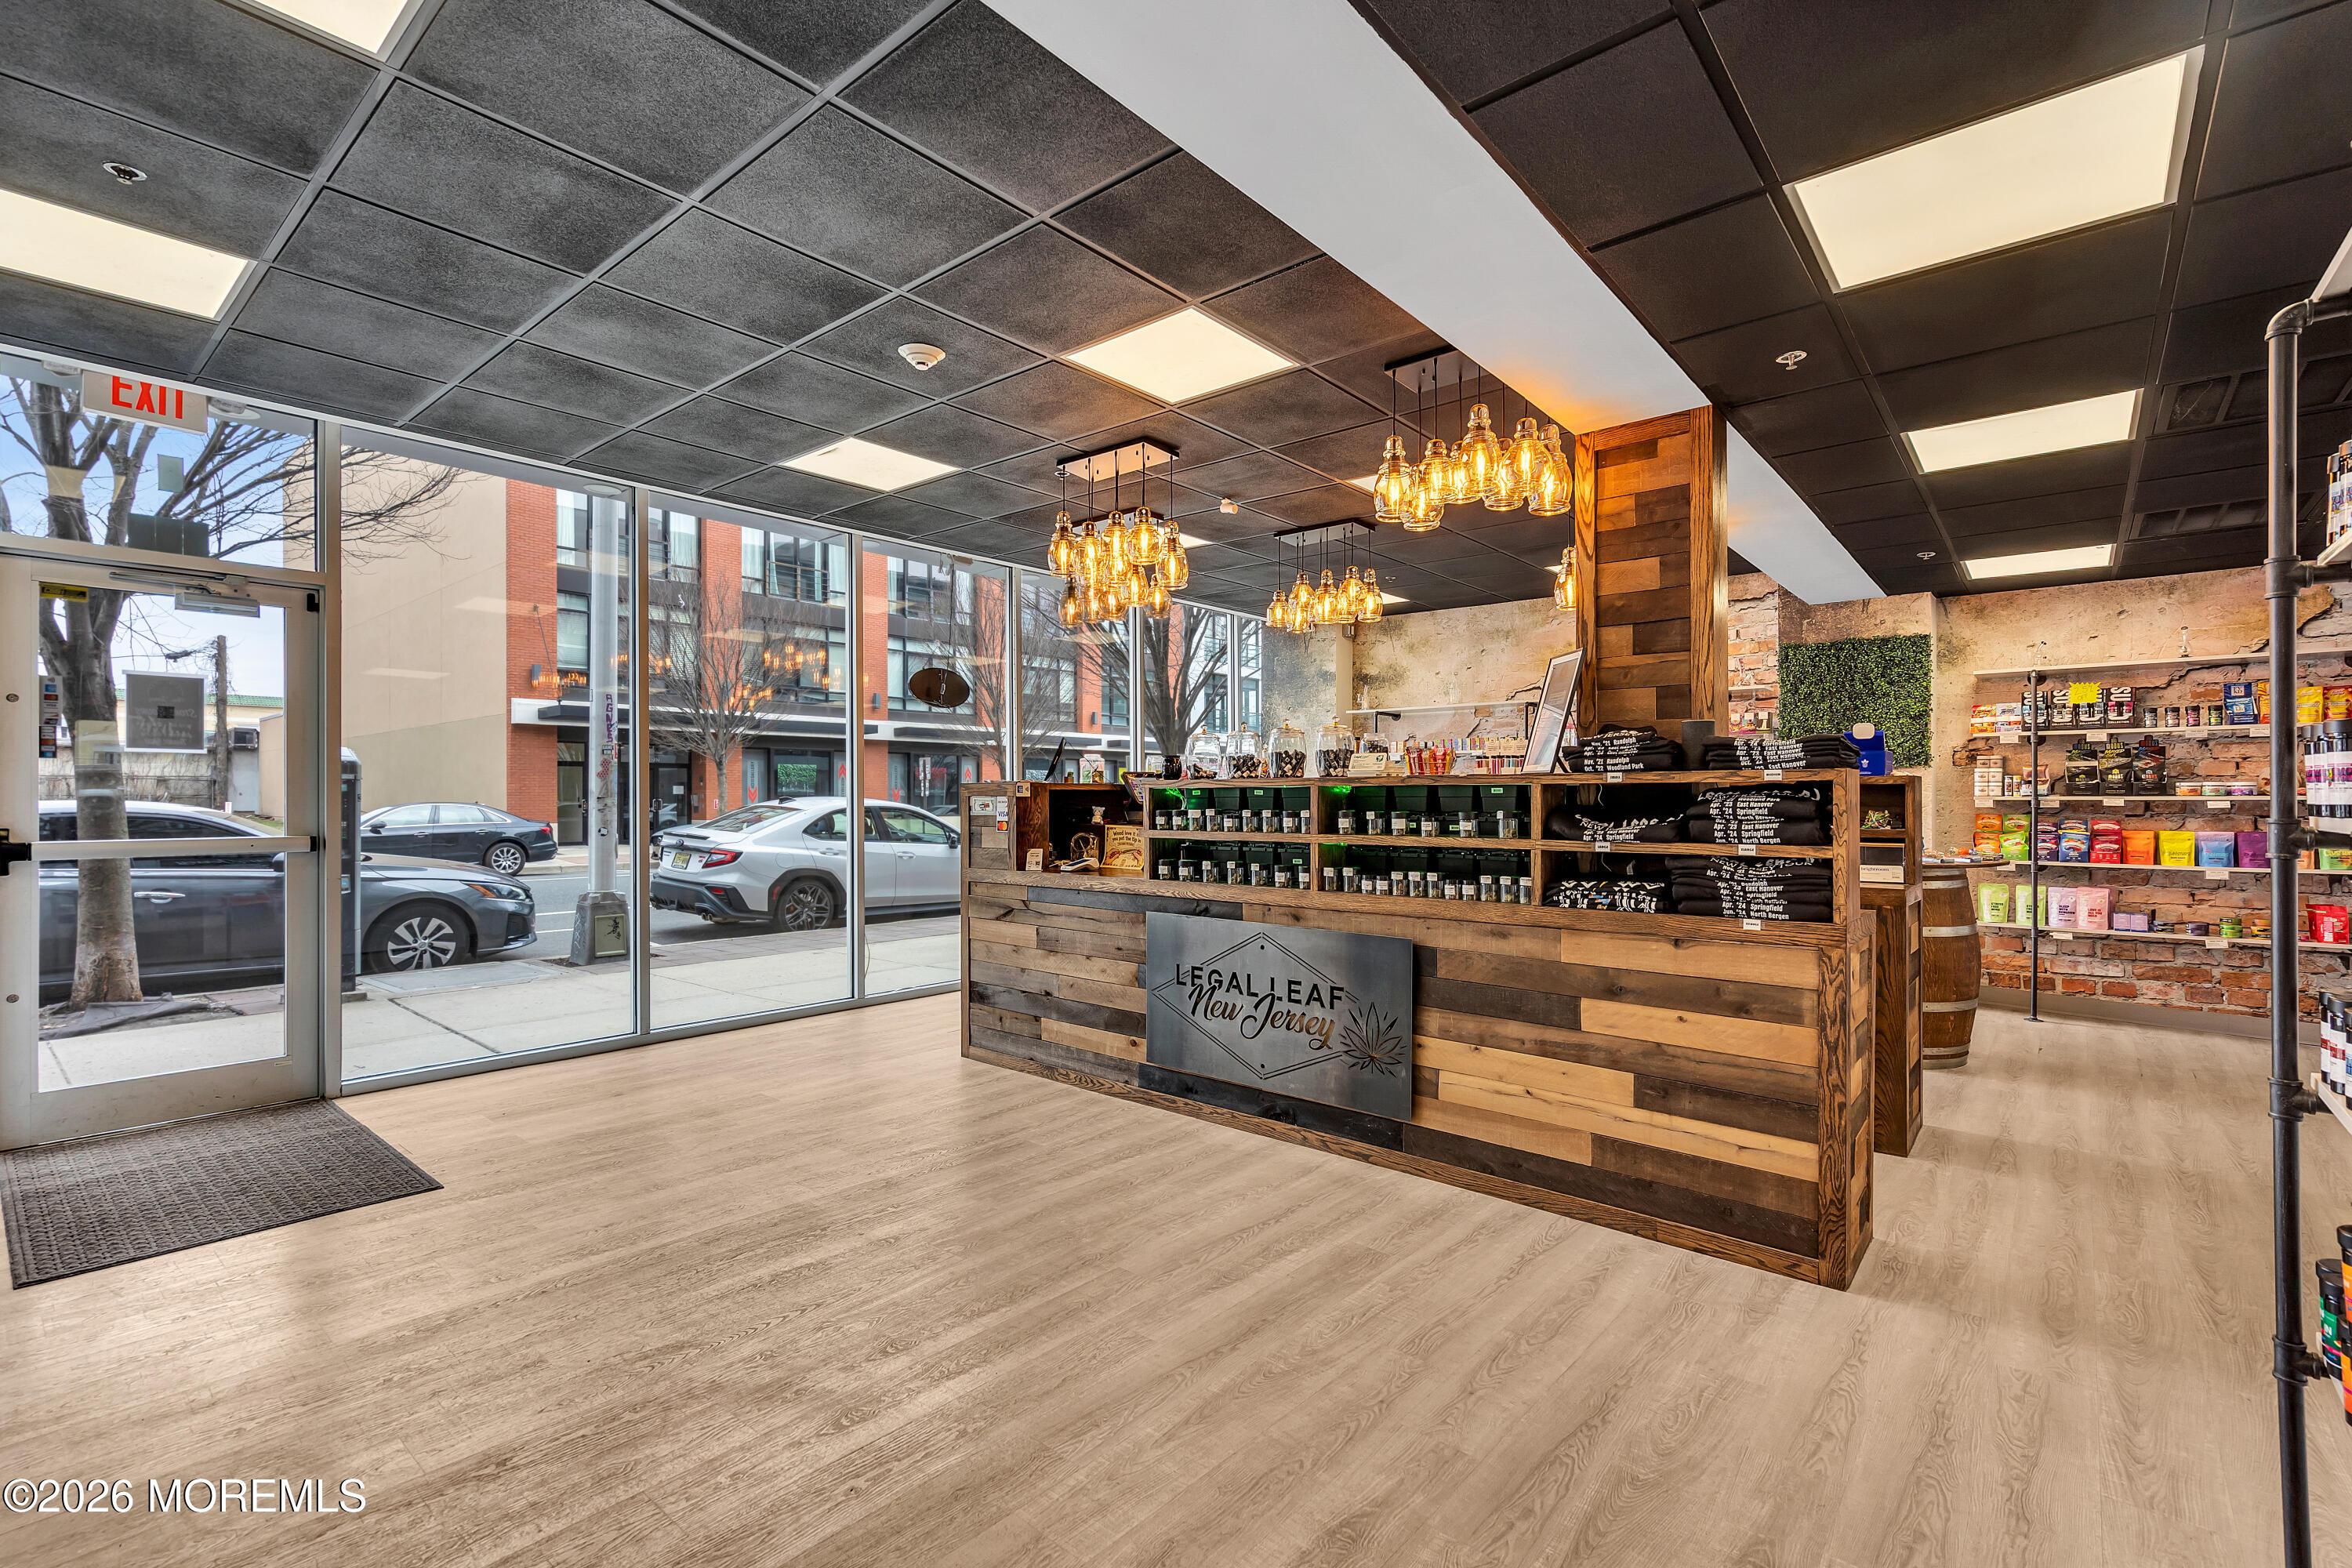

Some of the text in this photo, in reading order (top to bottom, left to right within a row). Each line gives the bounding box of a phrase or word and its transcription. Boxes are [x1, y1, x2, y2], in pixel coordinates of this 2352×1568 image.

[111, 376, 183, 419] EXIT
[1782, 760, 1806, 768] Hanover
[1750, 903, 1783, 912] Springfield
[1175, 963, 1345, 1010] LEGAL LEAF
[1188, 983, 1336, 1051] New Jersey
